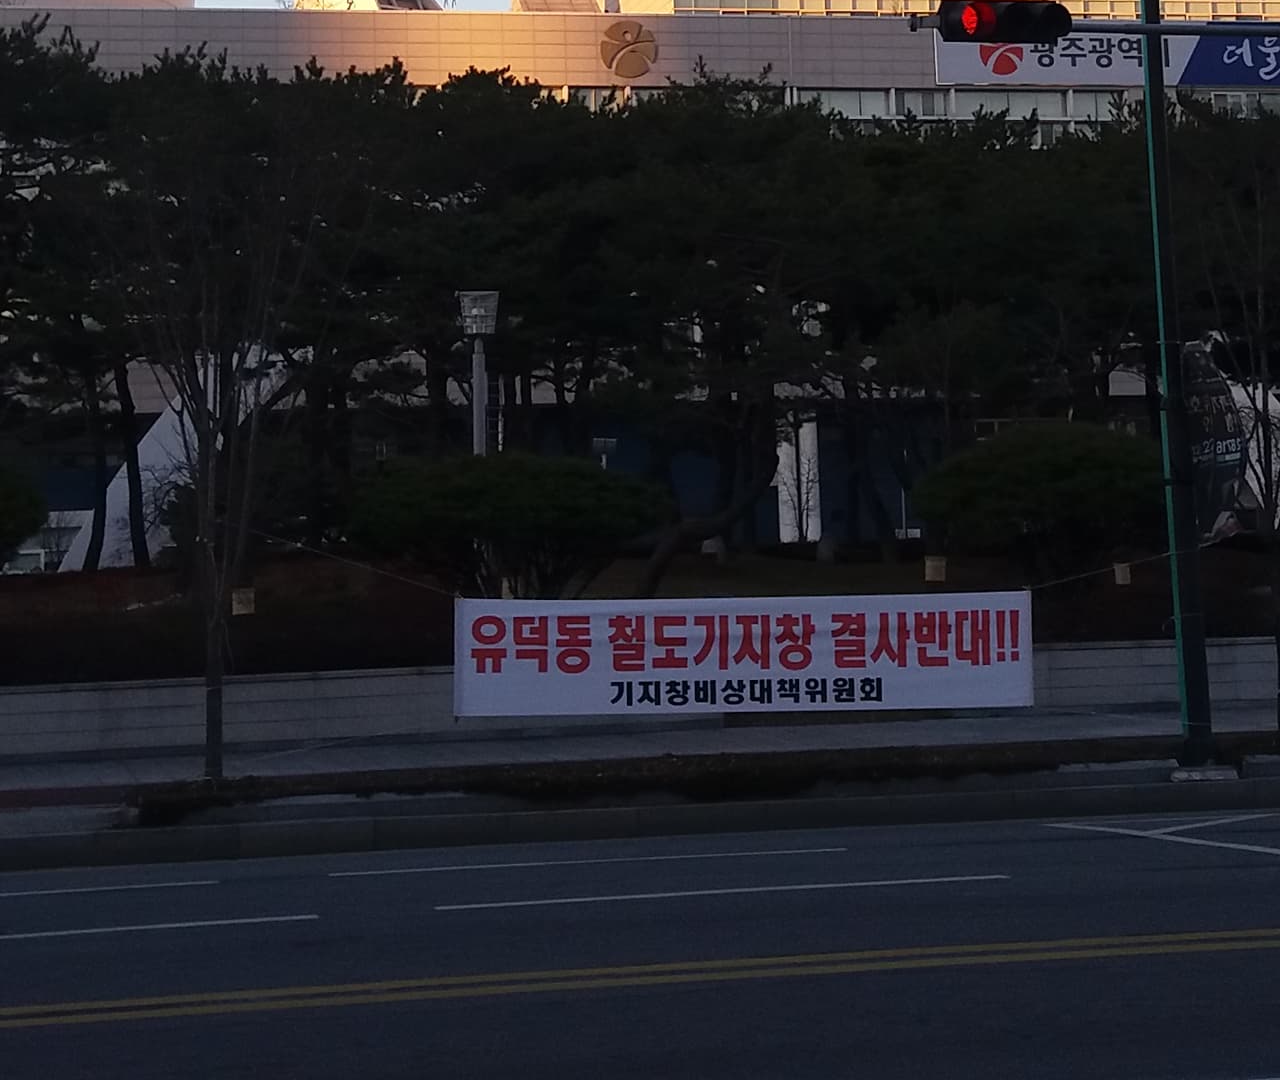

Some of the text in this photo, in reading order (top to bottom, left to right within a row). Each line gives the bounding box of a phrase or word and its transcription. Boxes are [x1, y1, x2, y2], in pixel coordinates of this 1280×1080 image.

[470, 609, 1021, 674] 유덕동 철도기지창 결사반대!!
[610, 676, 884, 706] 기지창비상대책위원회
